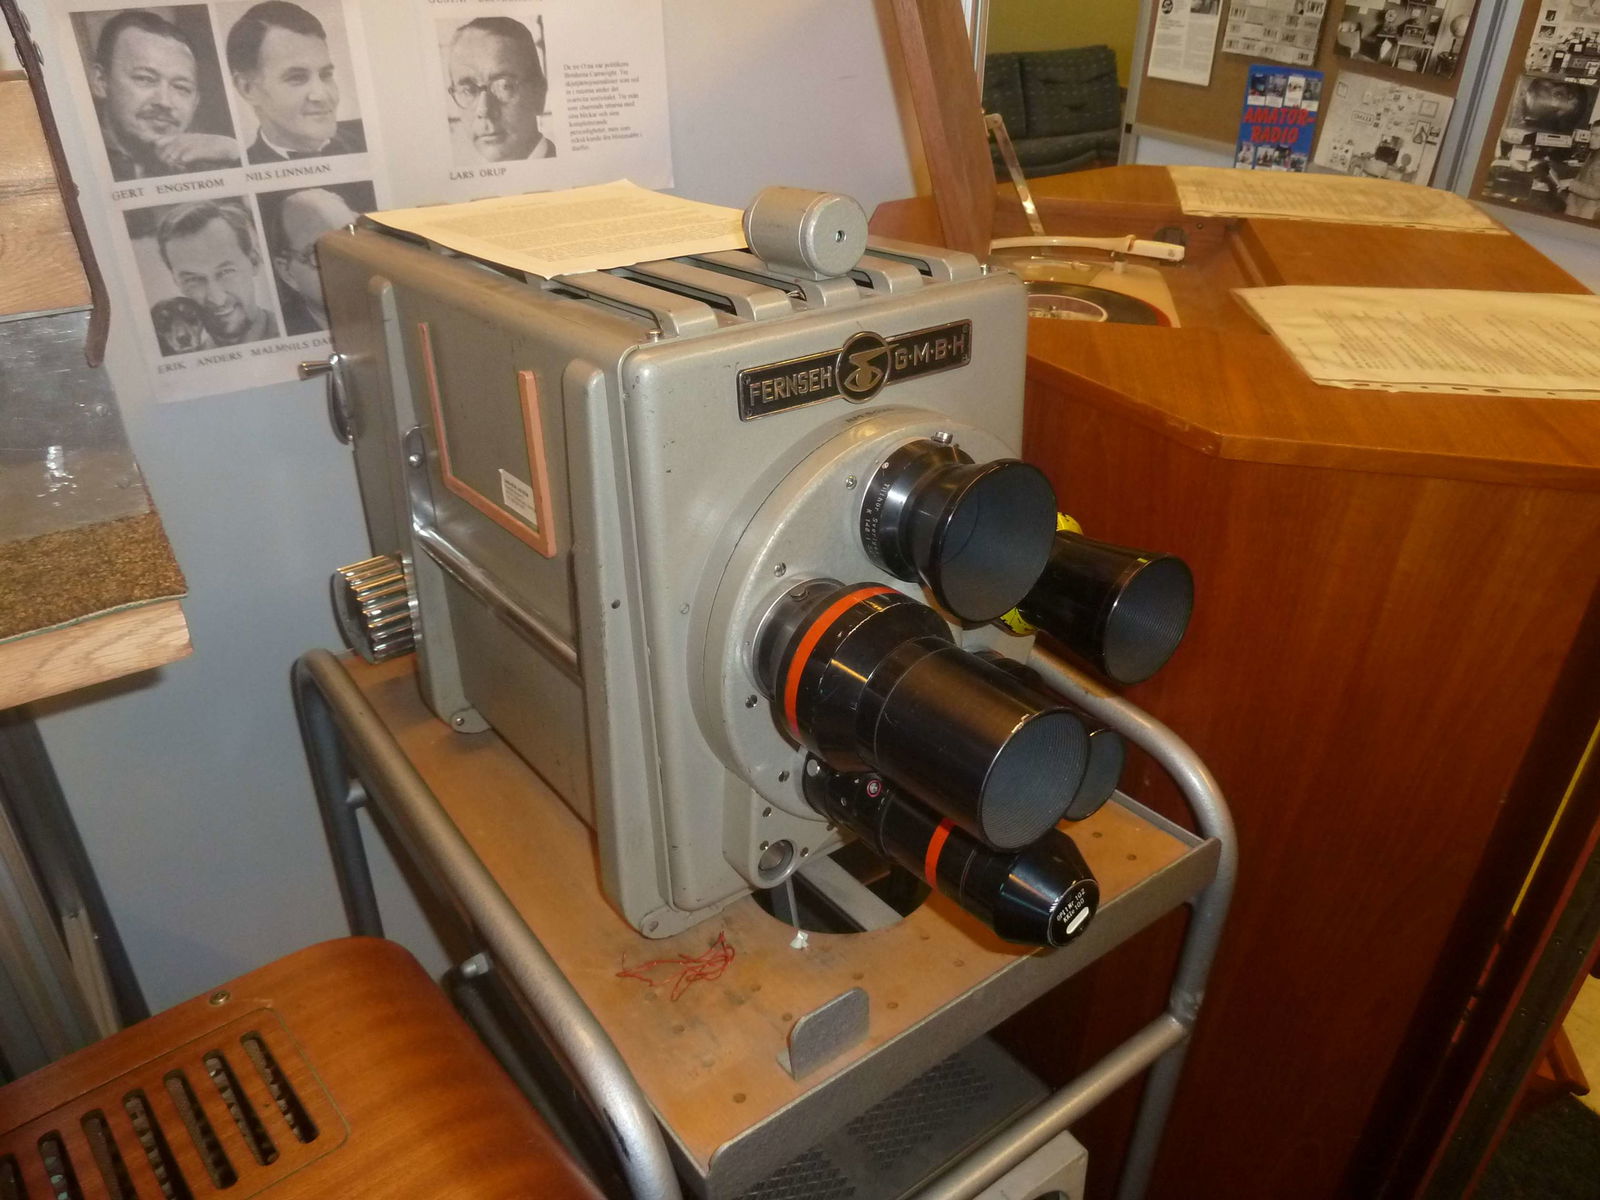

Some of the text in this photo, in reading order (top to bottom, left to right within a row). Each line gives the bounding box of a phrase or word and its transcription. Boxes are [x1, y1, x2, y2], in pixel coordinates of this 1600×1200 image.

[1244, 104, 1316, 126] AMATÖR-
[1251, 125, 1299, 144] RADIO
[245, 163, 332, 181] NILS LINNMAN
[449, 167, 507, 181] LARS ORUP
[111, 187, 145, 201] GERT
[157, 361, 187, 374] ERIK
[198, 351, 243, 367] ANDERS
[749, 365, 833, 407] FERNSEH
